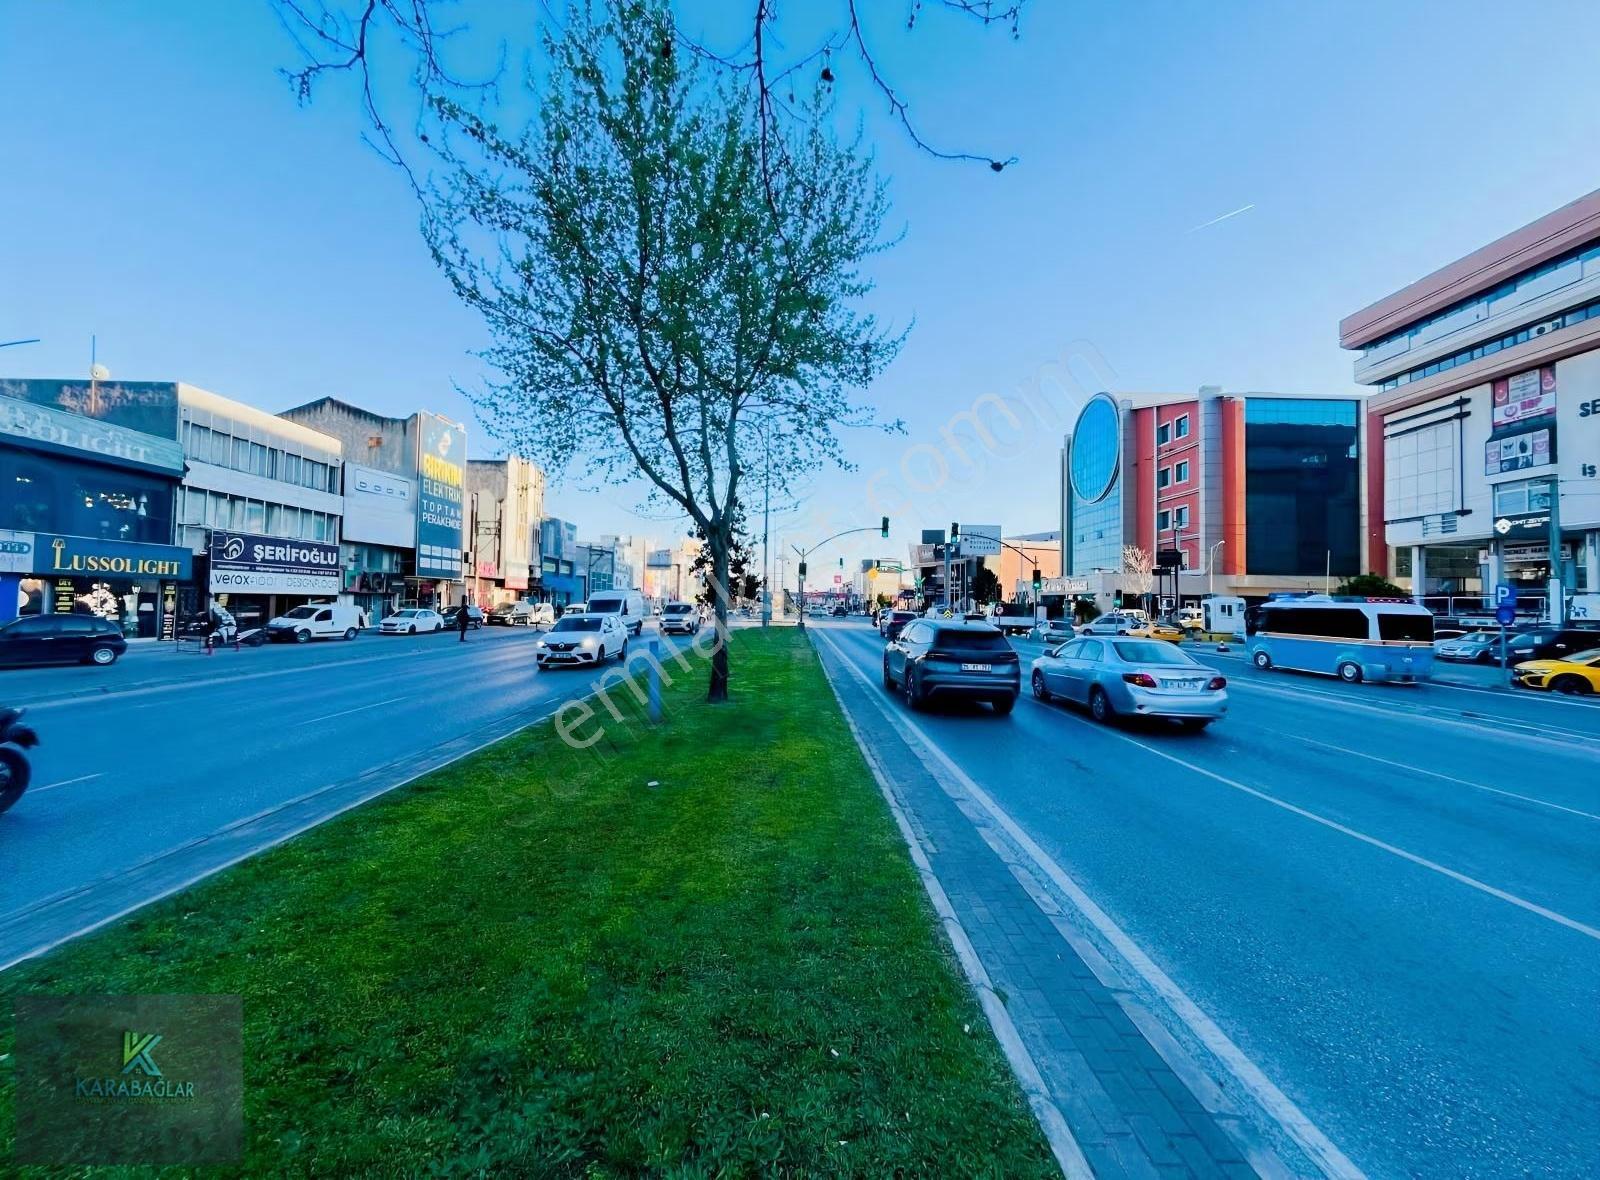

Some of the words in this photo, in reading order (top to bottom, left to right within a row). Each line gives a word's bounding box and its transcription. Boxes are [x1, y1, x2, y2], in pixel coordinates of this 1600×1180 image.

[422, 499, 462, 520] TOPTAN
[422, 511, 462, 530] PERAKENDE
[52, 538, 181, 575] LUSSOLIGHT
[253, 544, 337, 565] ŞERİFOĞLU
[1497, 586, 1510, 604] P
